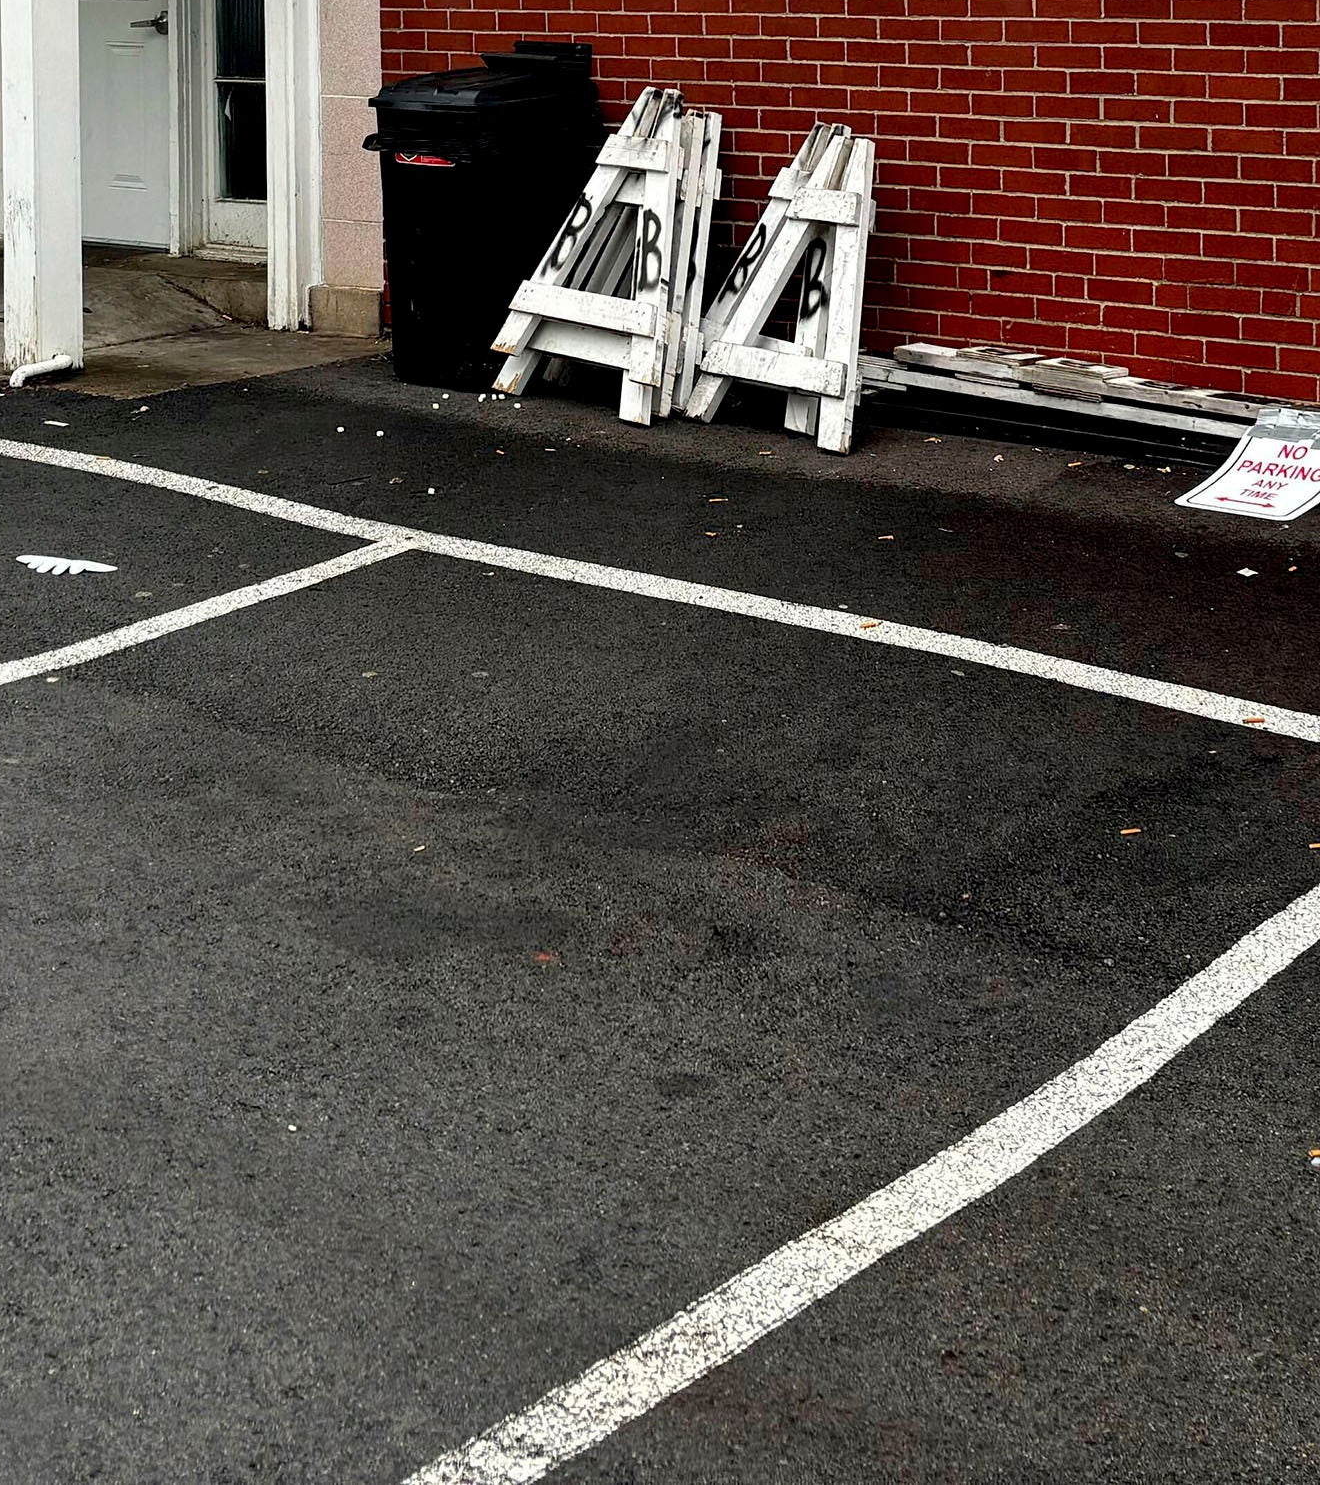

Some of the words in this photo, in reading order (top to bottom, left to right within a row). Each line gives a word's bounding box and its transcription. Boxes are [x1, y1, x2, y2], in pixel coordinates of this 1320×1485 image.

[540, 192, 592, 276] B
[637, 208, 663, 291] B
[799, 237, 829, 319] B
[1277, 444, 1308, 460] NO
[1240, 489, 1278, 501] TIME
[1251, 479, 1289, 490] ANY
